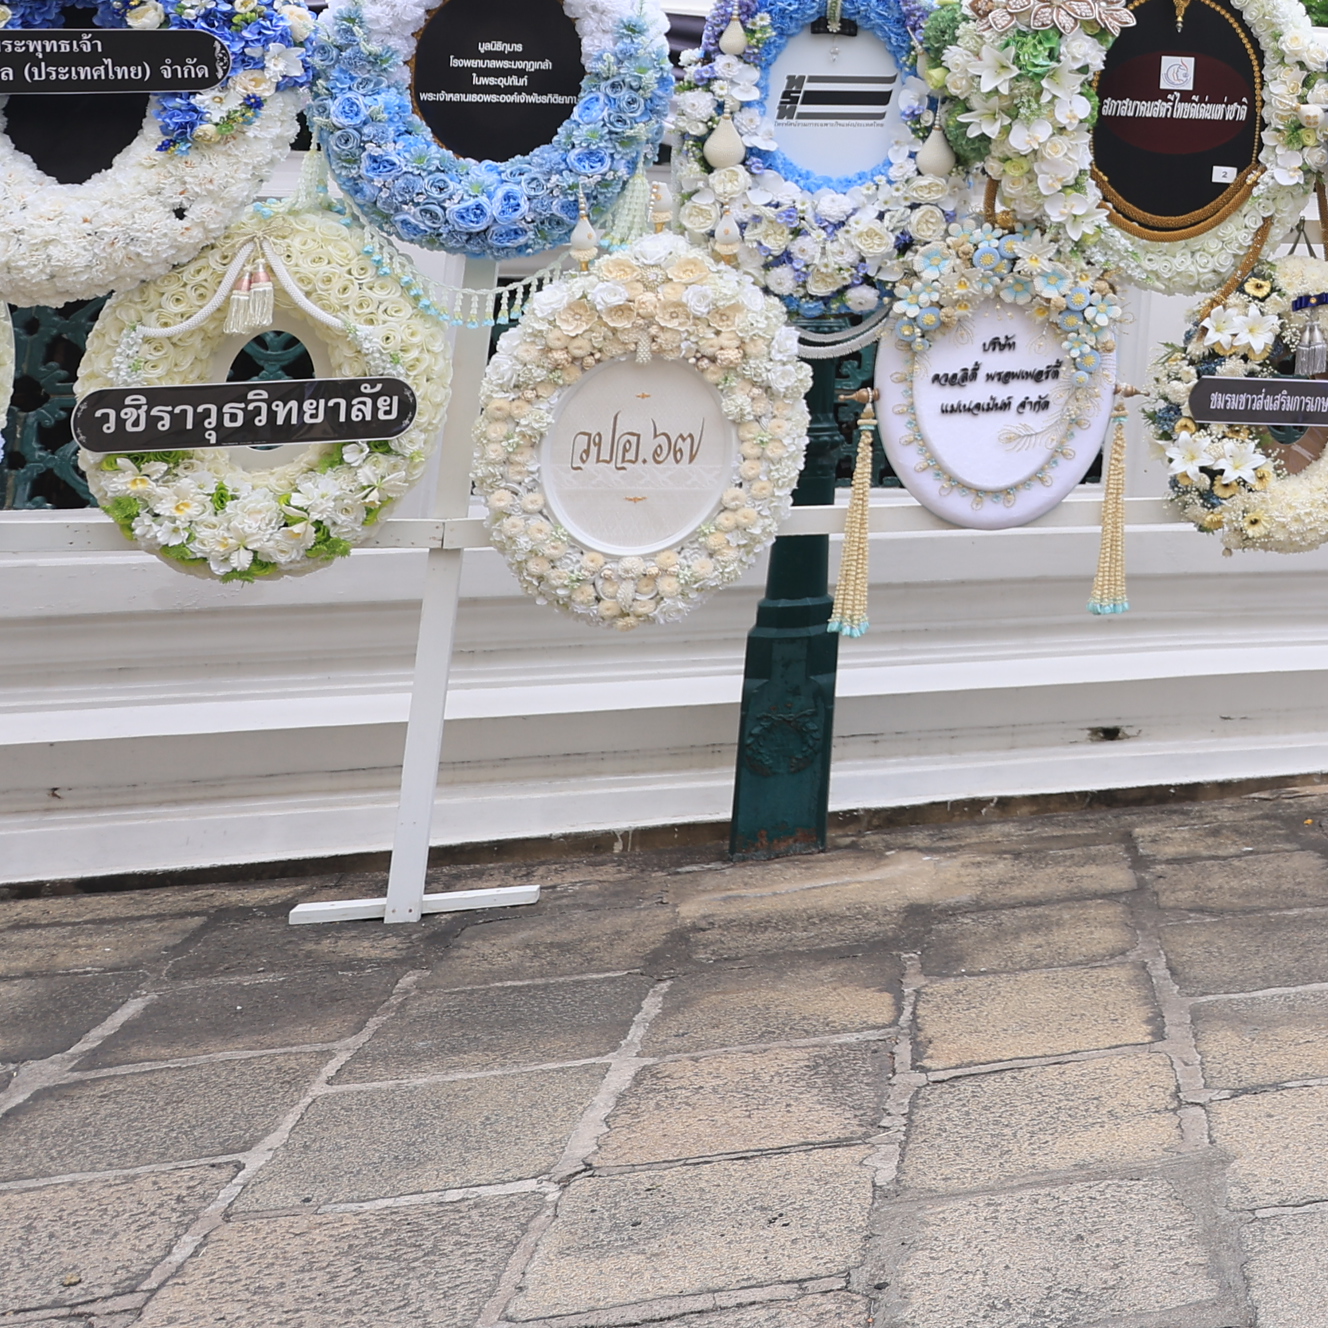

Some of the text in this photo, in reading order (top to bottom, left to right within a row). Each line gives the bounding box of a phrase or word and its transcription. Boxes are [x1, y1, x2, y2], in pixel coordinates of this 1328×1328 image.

[0, 33, 102, 58] ระพุทธเจ้า
[478, 41, 523, 54] มูลนิธิกุมาร
[24, 58, 151, 83] (ประเทศไทย)
[160, 57, 209, 80] จำกัด
[472, 73, 528, 88] ในพระอุปถัมภ์
[1101, 92, 1249, 121] สภาสมาคมสตรีไทยดีเด่นแห่งชาติ
[982, 334, 1016, 352] บริษัท
[94, 383, 399, 445] วชิราวุธวิทยาลัย
[1016, 393, 1050, 414] จำกัด
